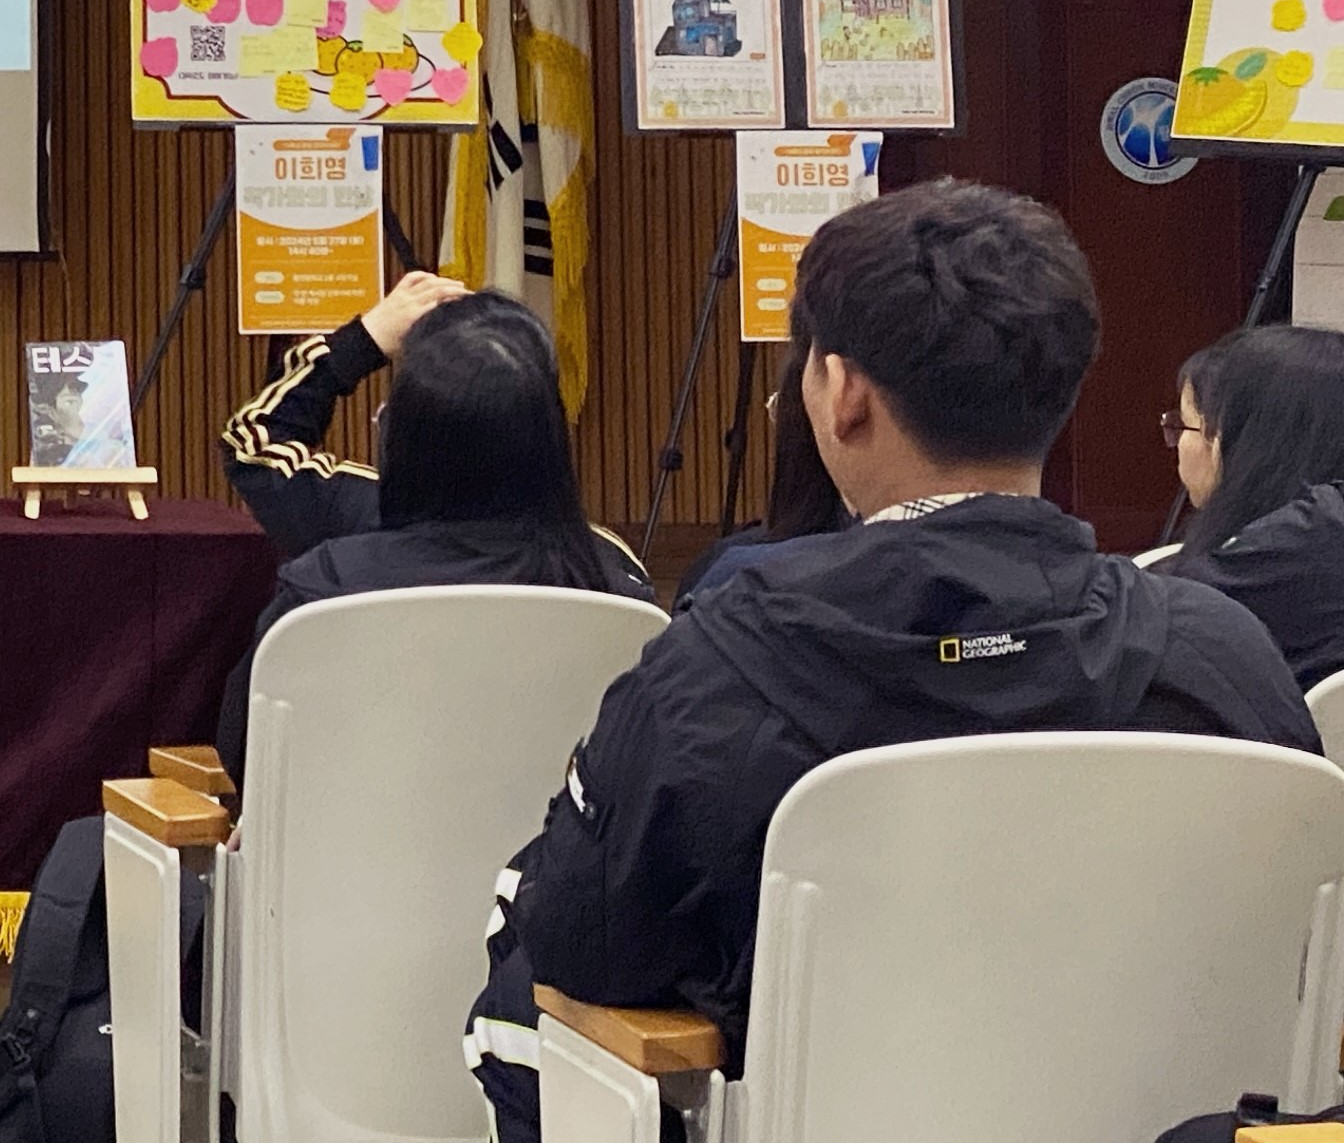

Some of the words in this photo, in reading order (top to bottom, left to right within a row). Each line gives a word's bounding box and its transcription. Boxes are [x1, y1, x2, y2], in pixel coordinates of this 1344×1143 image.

[275, 156, 346, 180] 이희영
[777, 163, 849, 187] 이희영
[962, 633, 1013, 650] NATIONAL
[962, 640, 1027, 659] GEOGRAPHIC
